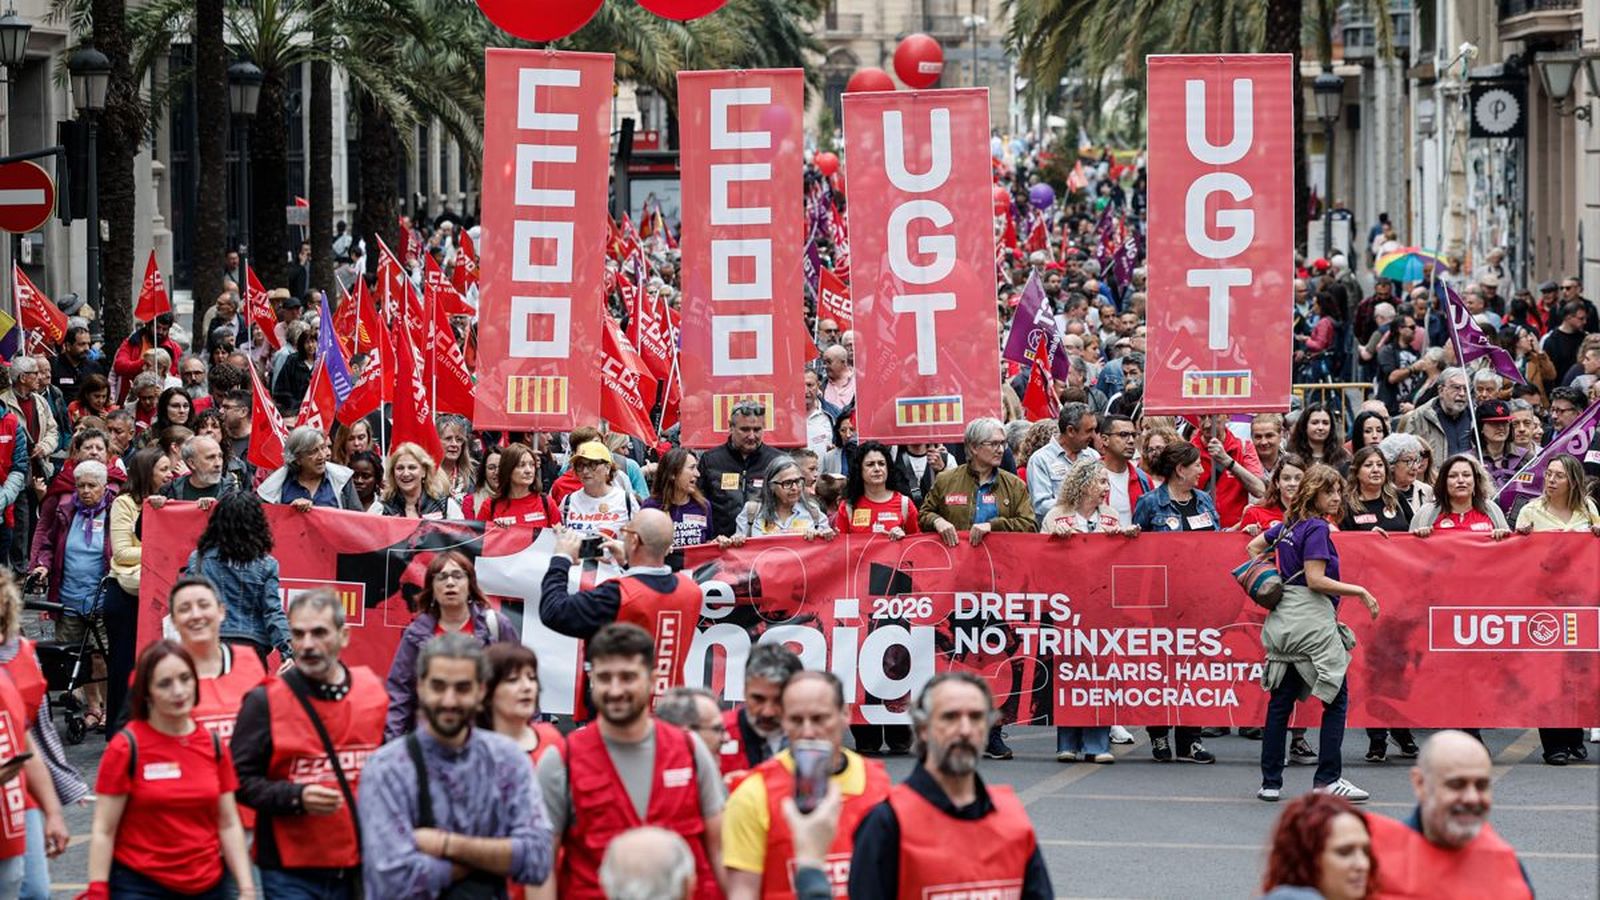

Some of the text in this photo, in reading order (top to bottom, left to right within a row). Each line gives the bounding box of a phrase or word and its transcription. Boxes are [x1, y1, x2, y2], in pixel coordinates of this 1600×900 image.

[509, 68, 580, 358] CCOO
[1185, 78, 1255, 350] UGT
[710, 87, 774, 376] CCOO
[884, 108, 957, 375] UGT
[822, 288, 853, 313] CCO
[872, 597, 933, 620] 2026
[954, 593, 1081, 626] DRETS,
[954, 627, 1232, 656] NO TRINXERES.
[1453, 615, 1527, 645] UGT
[1059, 663, 1263, 684] SALARIS, HABITA
[1059, 686, 1240, 707] I DEMOCRÀCIA
